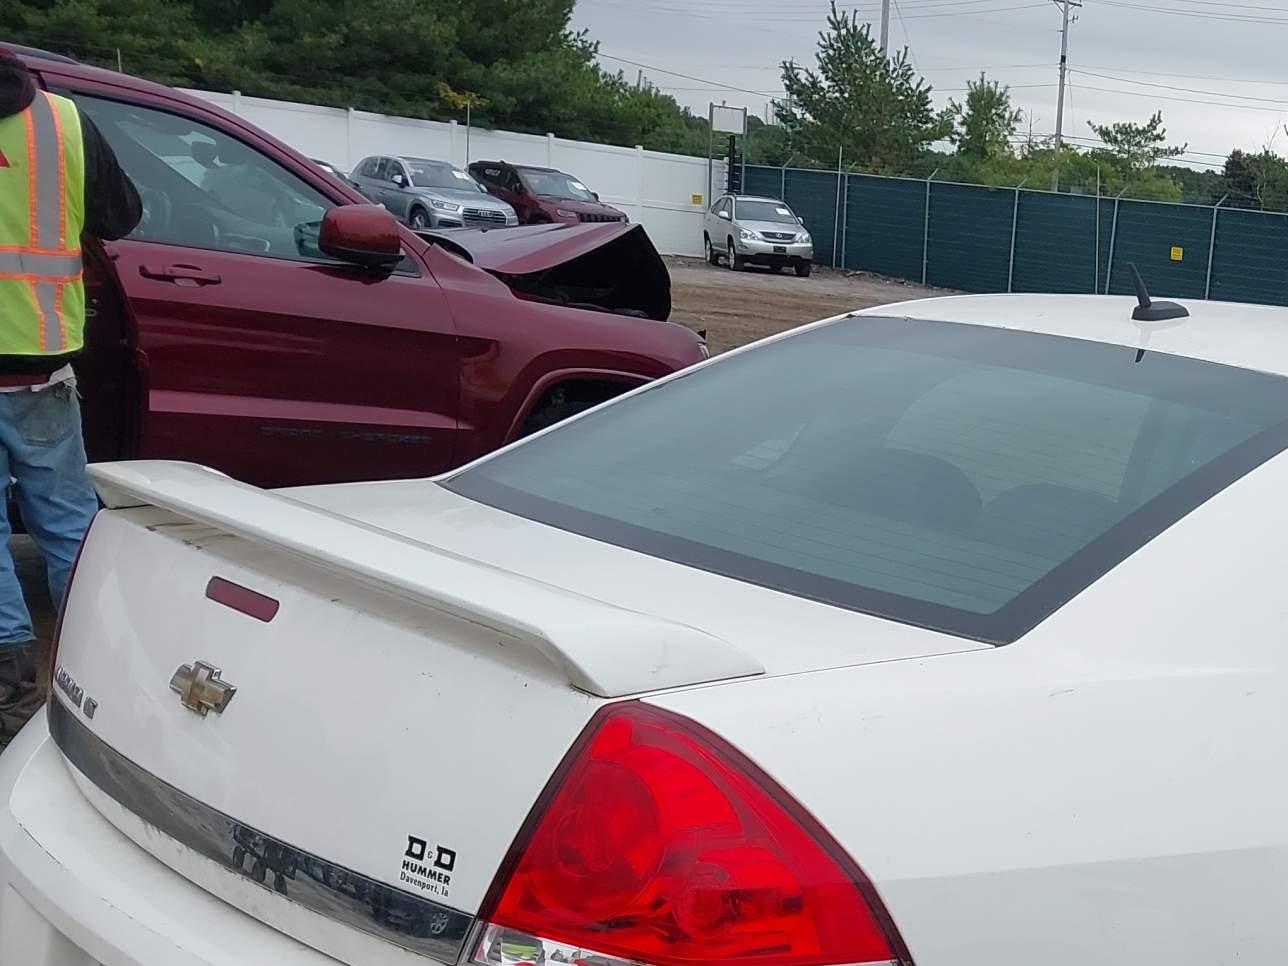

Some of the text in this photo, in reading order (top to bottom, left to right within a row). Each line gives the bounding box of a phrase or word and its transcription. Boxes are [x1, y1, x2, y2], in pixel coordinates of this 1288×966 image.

[405, 834, 427, 861] D
[434, 845, 456, 871] D
[401, 872, 439, 895] Davenport,
[402, 860, 450, 885] HUMMER
